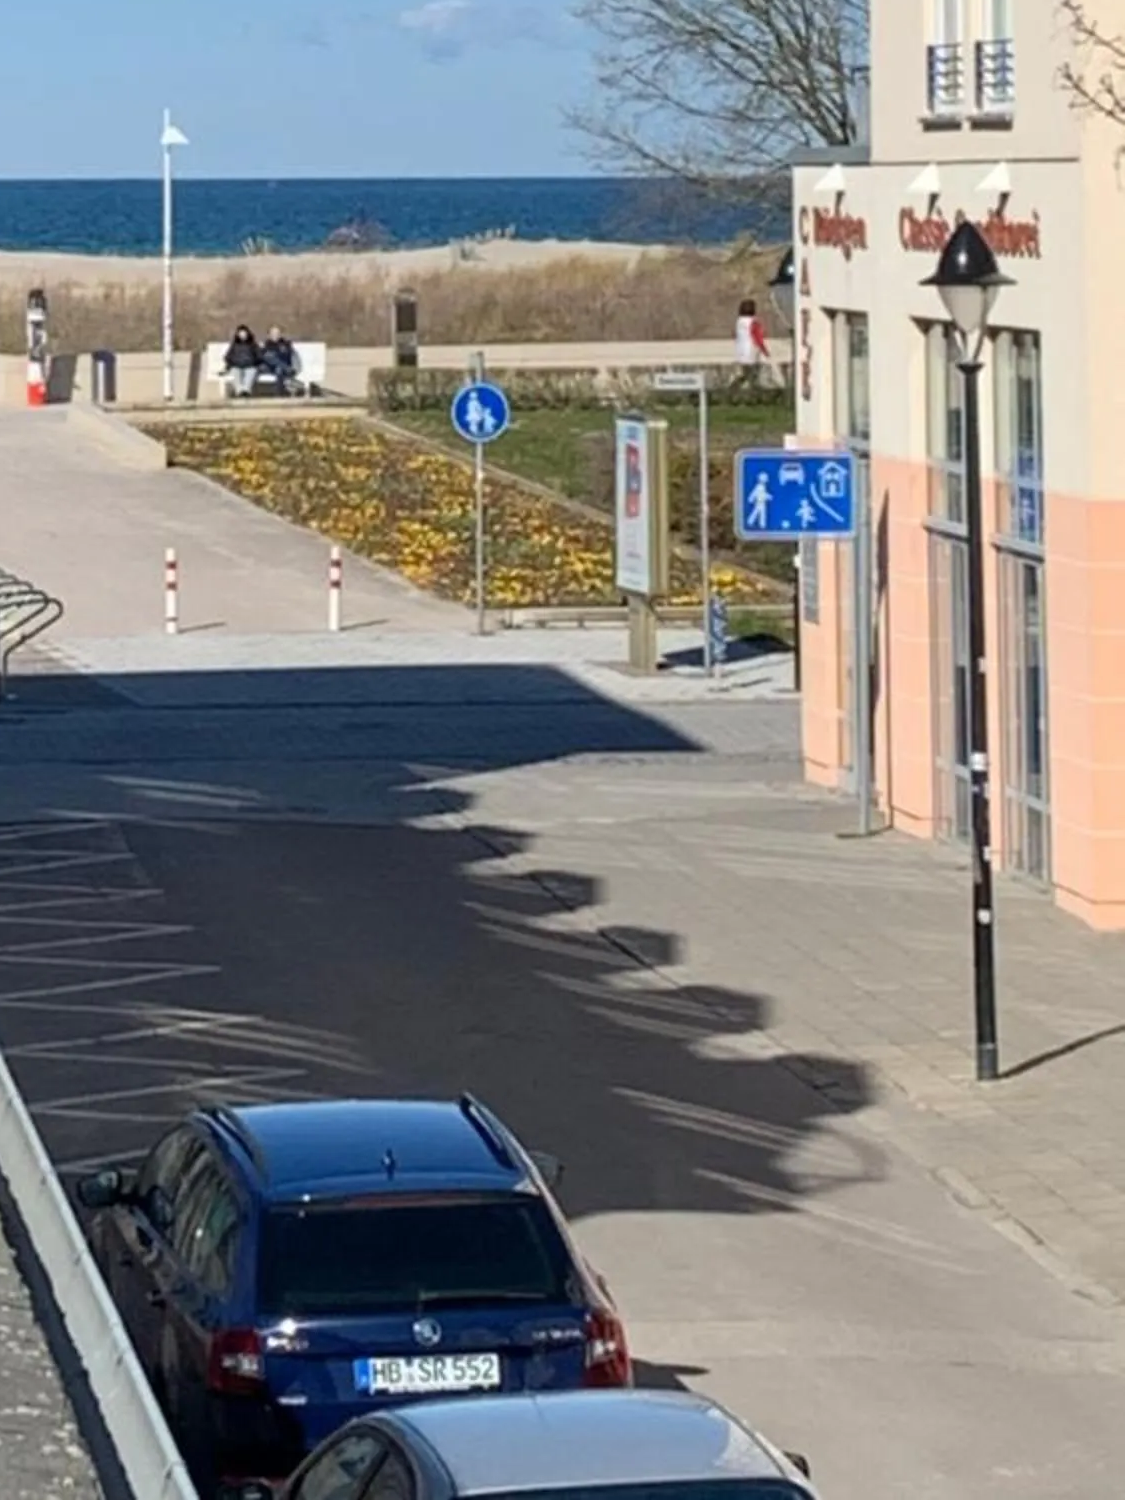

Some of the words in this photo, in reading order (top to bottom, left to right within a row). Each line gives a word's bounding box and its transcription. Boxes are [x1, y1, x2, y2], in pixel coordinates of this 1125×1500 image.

[372, 1359, 402, 1383] HB
[417, 1357, 447, 1382] SR
[452, 1355, 494, 1381] 552
